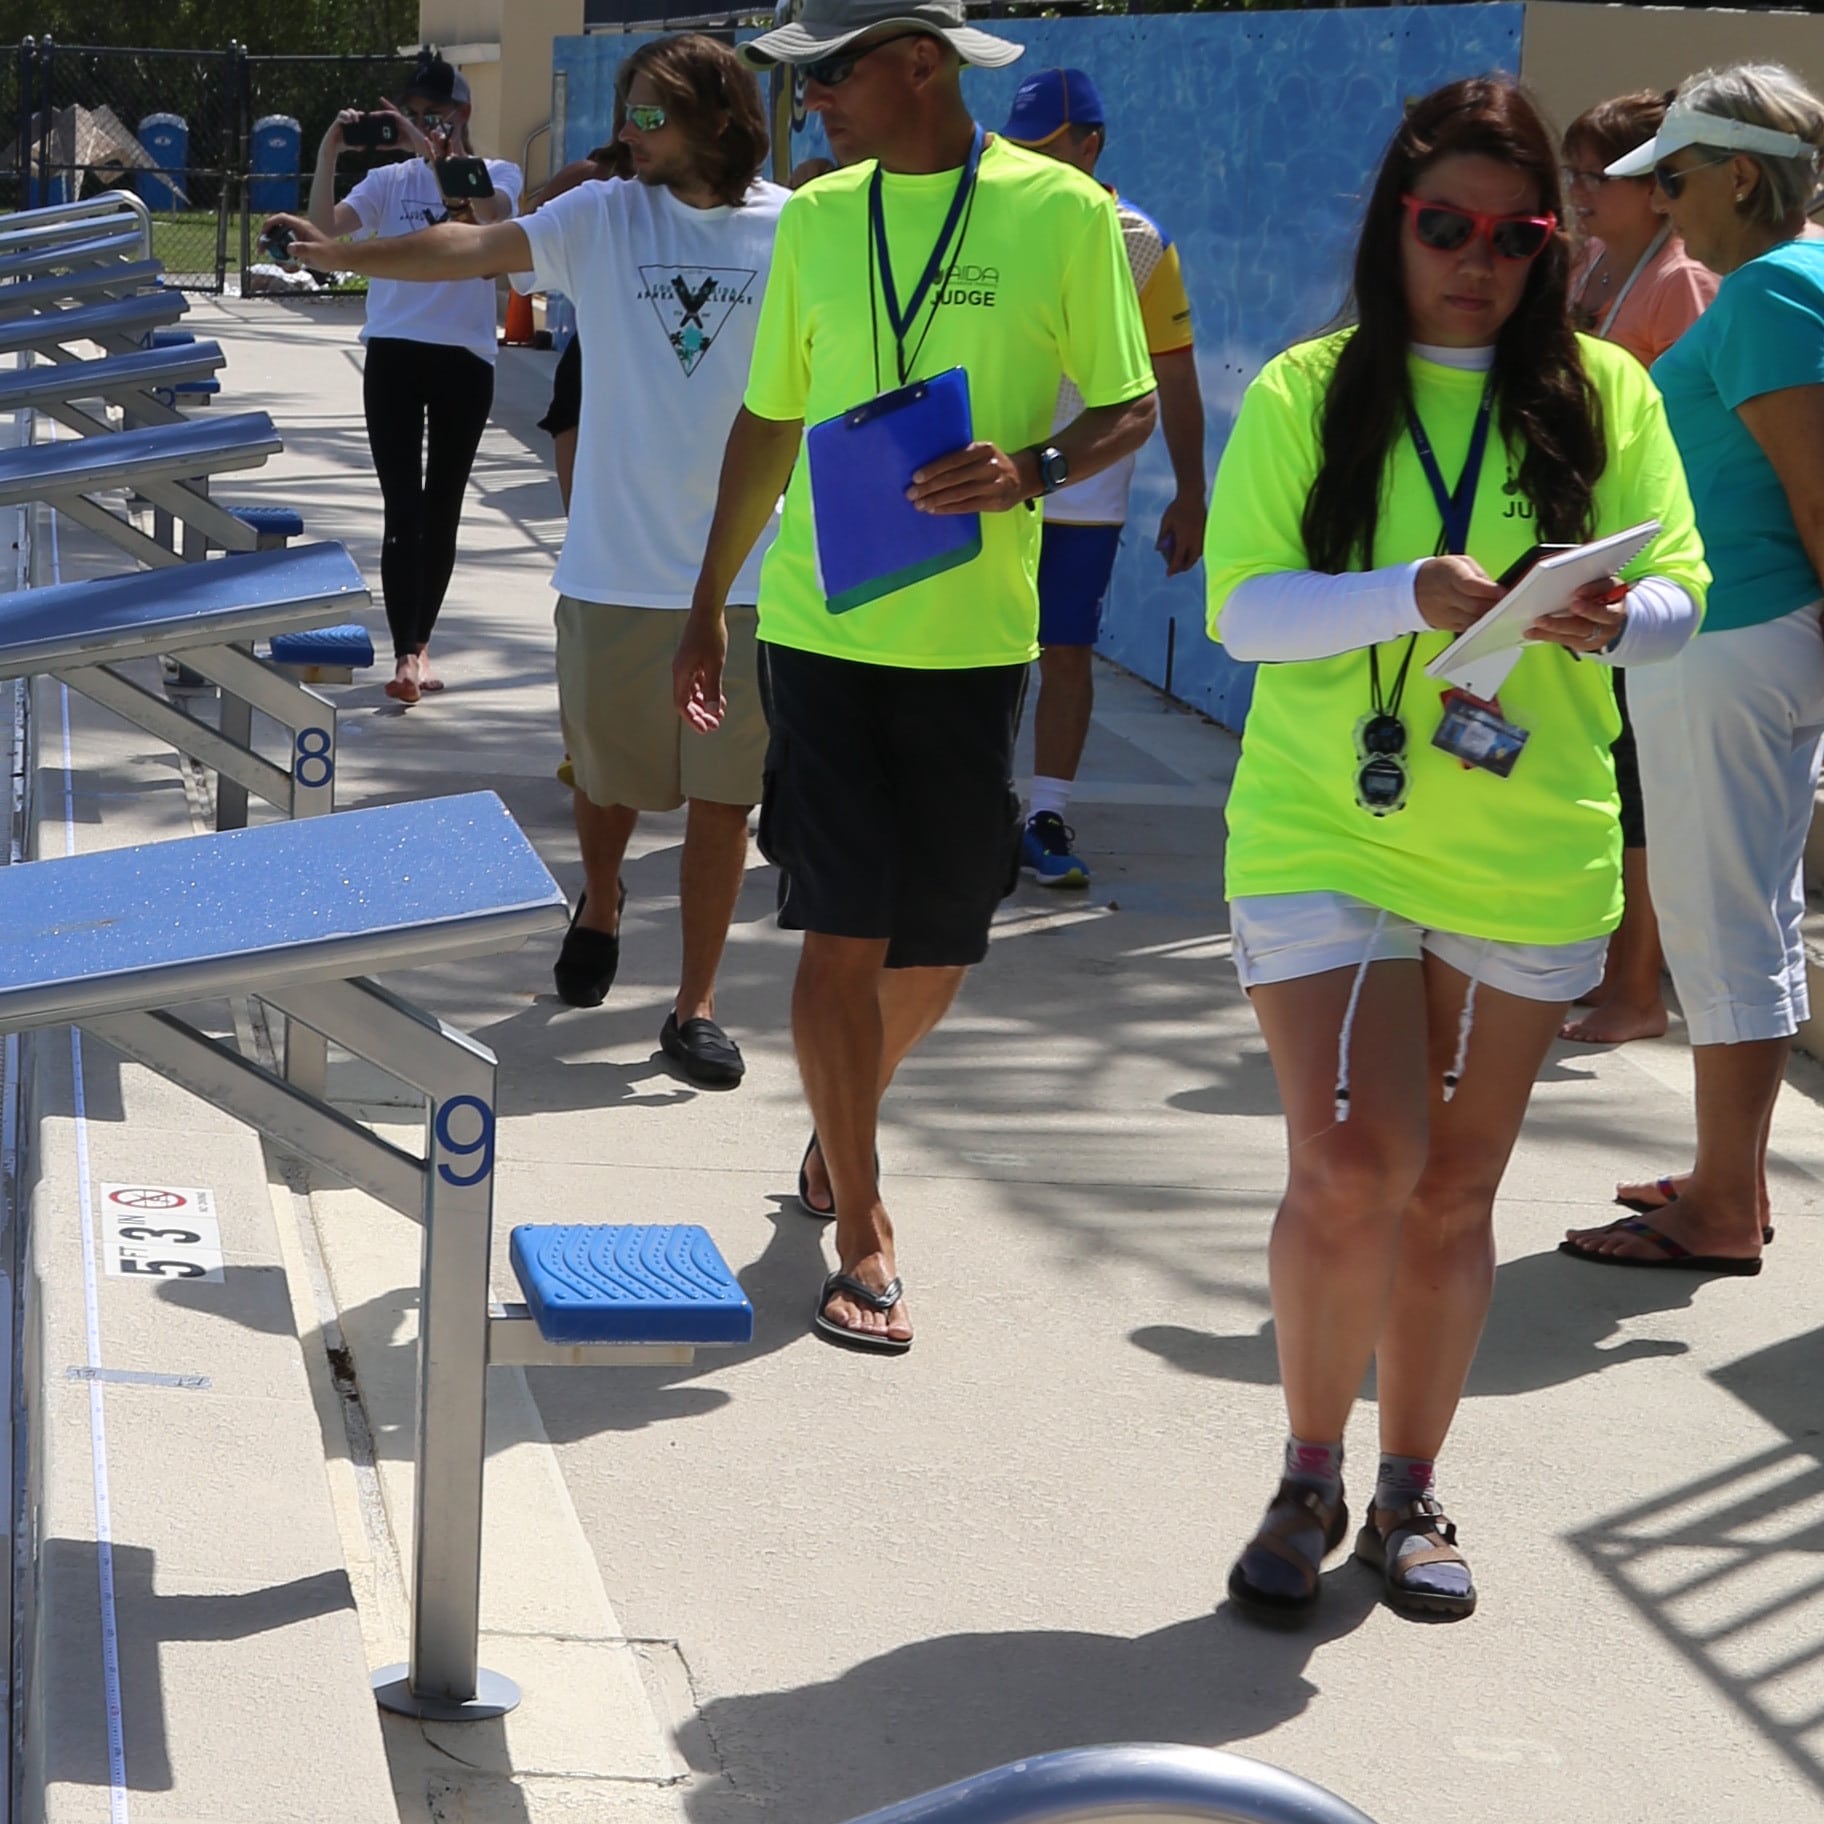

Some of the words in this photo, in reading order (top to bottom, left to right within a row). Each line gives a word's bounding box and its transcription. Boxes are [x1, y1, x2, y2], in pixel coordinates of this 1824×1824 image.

[930, 290, 995, 307] JUDGE
[296, 727, 334, 788] 8
[435, 1094, 495, 1186] 9
[117, 1214, 146, 1225] IN
[119, 1227, 202, 1243] 3
[119, 1246, 149, 1258] FT
[119, 1259, 206, 1278] 5
